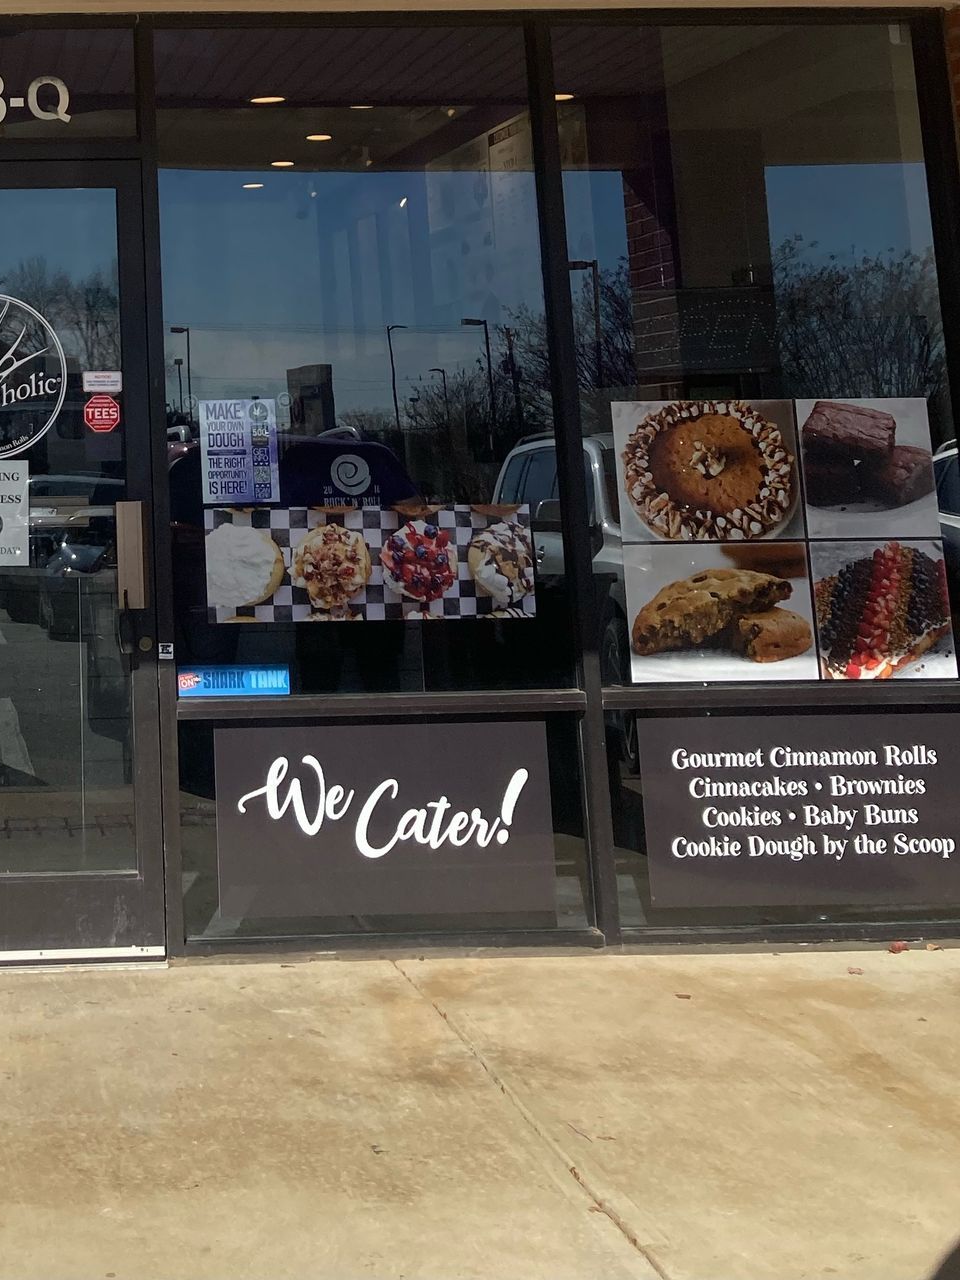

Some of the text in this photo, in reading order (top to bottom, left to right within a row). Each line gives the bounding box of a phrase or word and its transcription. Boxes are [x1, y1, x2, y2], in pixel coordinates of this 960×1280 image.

[86, 408, 118, 419] TEES
[206, 403, 243, 420] MAKE
[207, 421, 245, 432] YOUR OWN
[208, 432, 245, 448] DOUGH
[208, 457, 246, 469] THE RIGHT
[208, 470, 247, 480] OPPORTUNITY
[209, 480, 247, 495] IS HERE!
[203, 671, 245, 689] SHARK
[249, 670, 288, 689] TANK
[672, 745, 938, 770] Gourmet Cinnamon Rolls
[689, 775, 926, 799] Cinnacakes Brownies
[238, 754, 529, 859] We Cater!
[702, 804, 919, 831] Cookies Baby Buns
[672, 832, 956, 861] Cookie Dough by the Scoop
